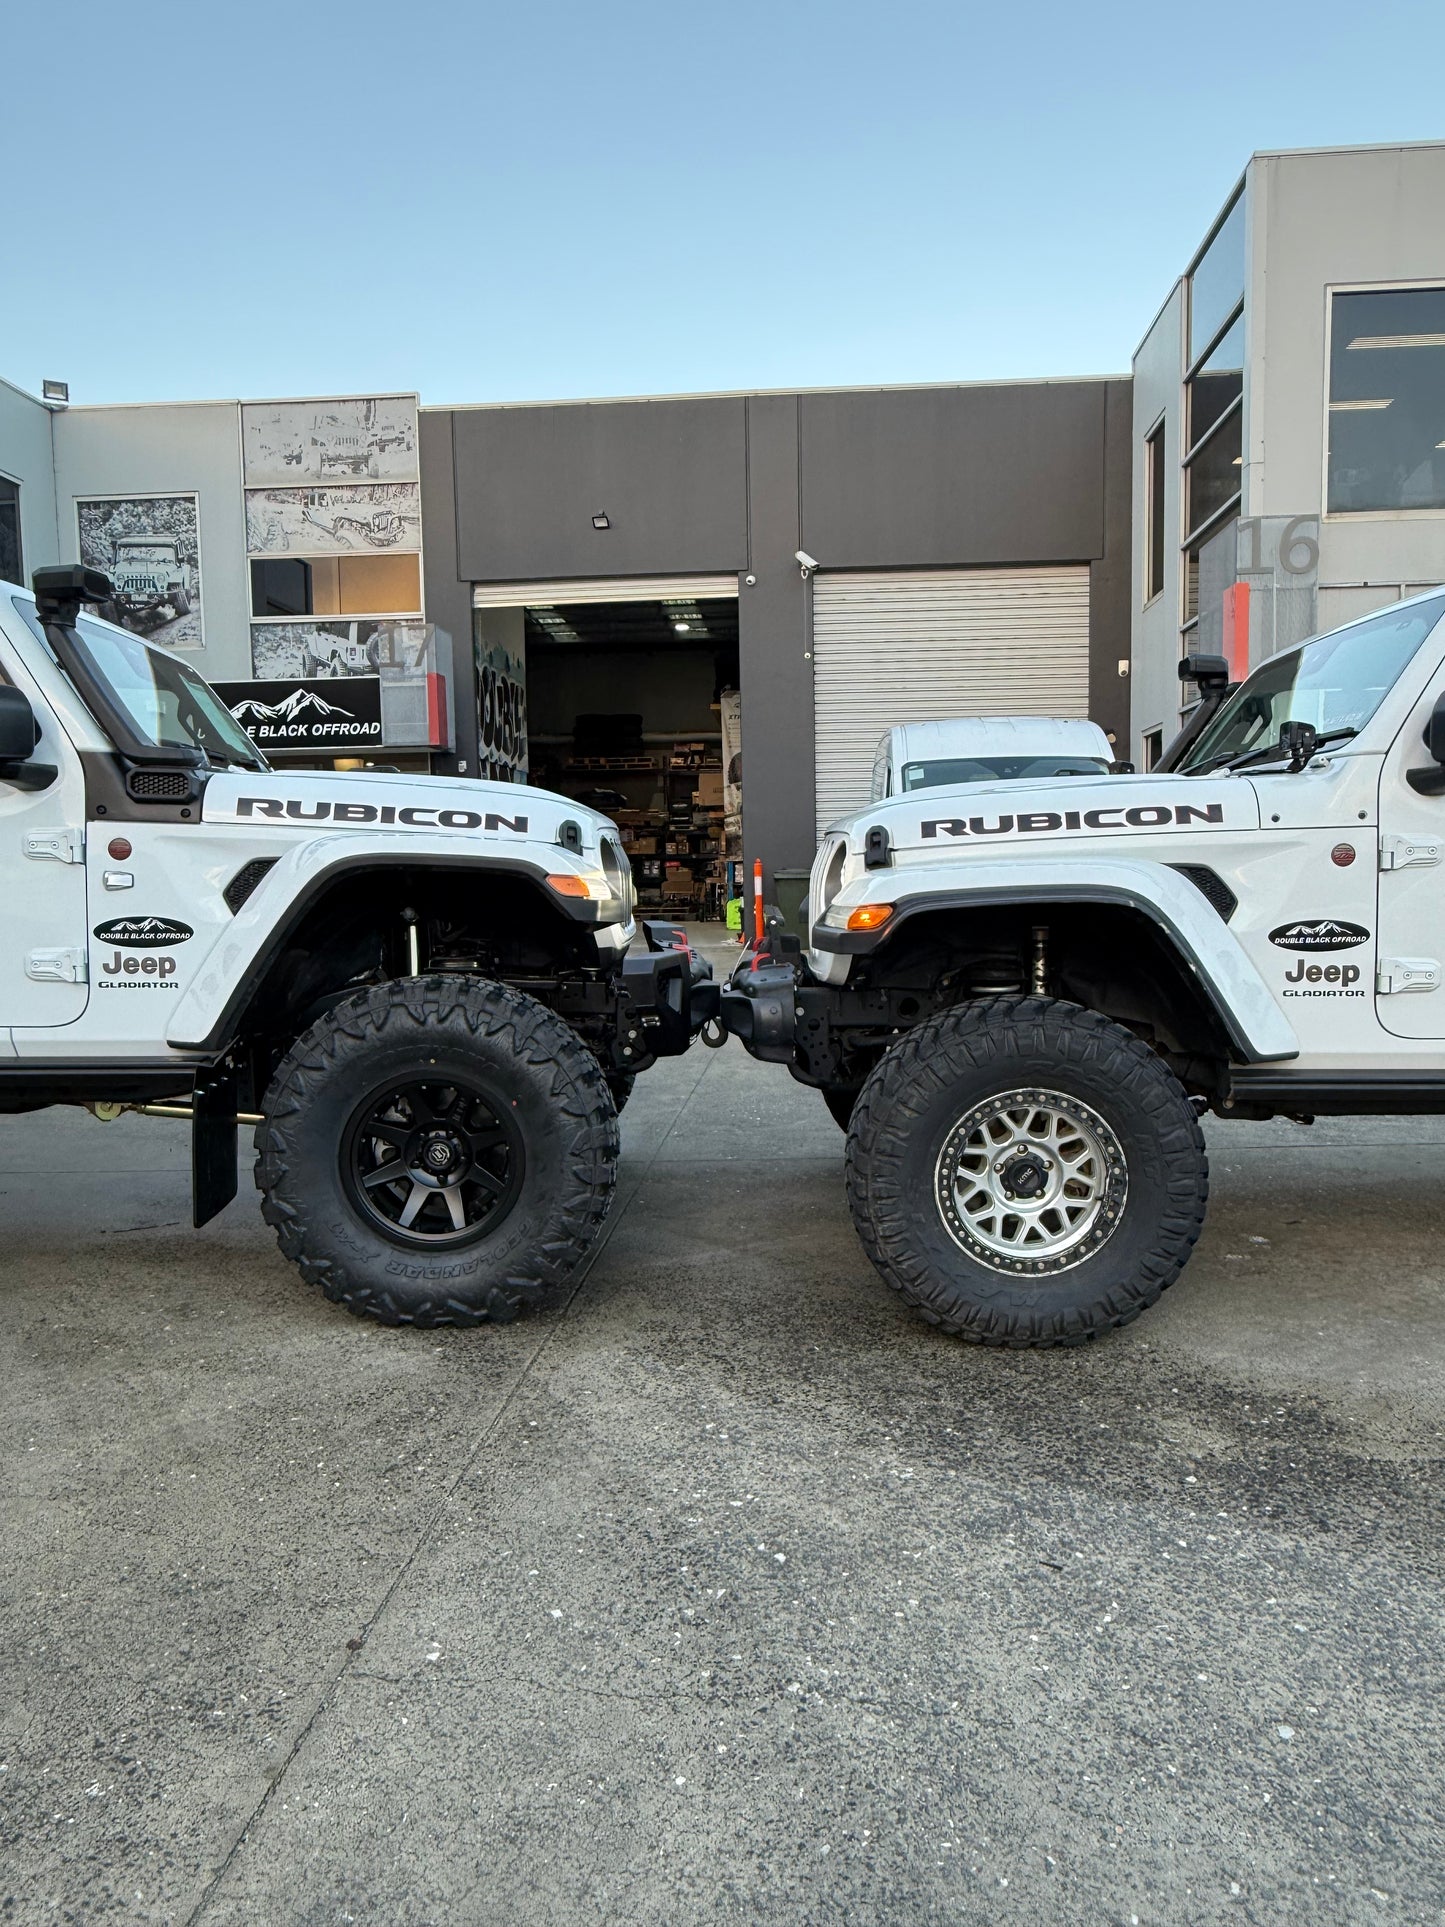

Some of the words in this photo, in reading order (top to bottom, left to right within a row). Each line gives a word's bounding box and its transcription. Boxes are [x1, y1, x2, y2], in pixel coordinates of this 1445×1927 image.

[1237, 513, 1320, 575] 16
[379, 622, 435, 667] 17
[259, 724, 308, 738] BLACK
[312, 722, 381, 737] OFFROAD
[236, 797, 529, 833] RUBICON
[921, 803, 1223, 839] RUBICON
[1305, 936, 1331, 944] BLACK
[1331, 935, 1367, 943] OFFROAD
[102, 951, 177, 979] Jeep
[1285, 958, 1361, 988] Jeep
[98, 981, 179, 989] GLADIATOR
[1282, 989, 1366, 997] GLADIATOR
